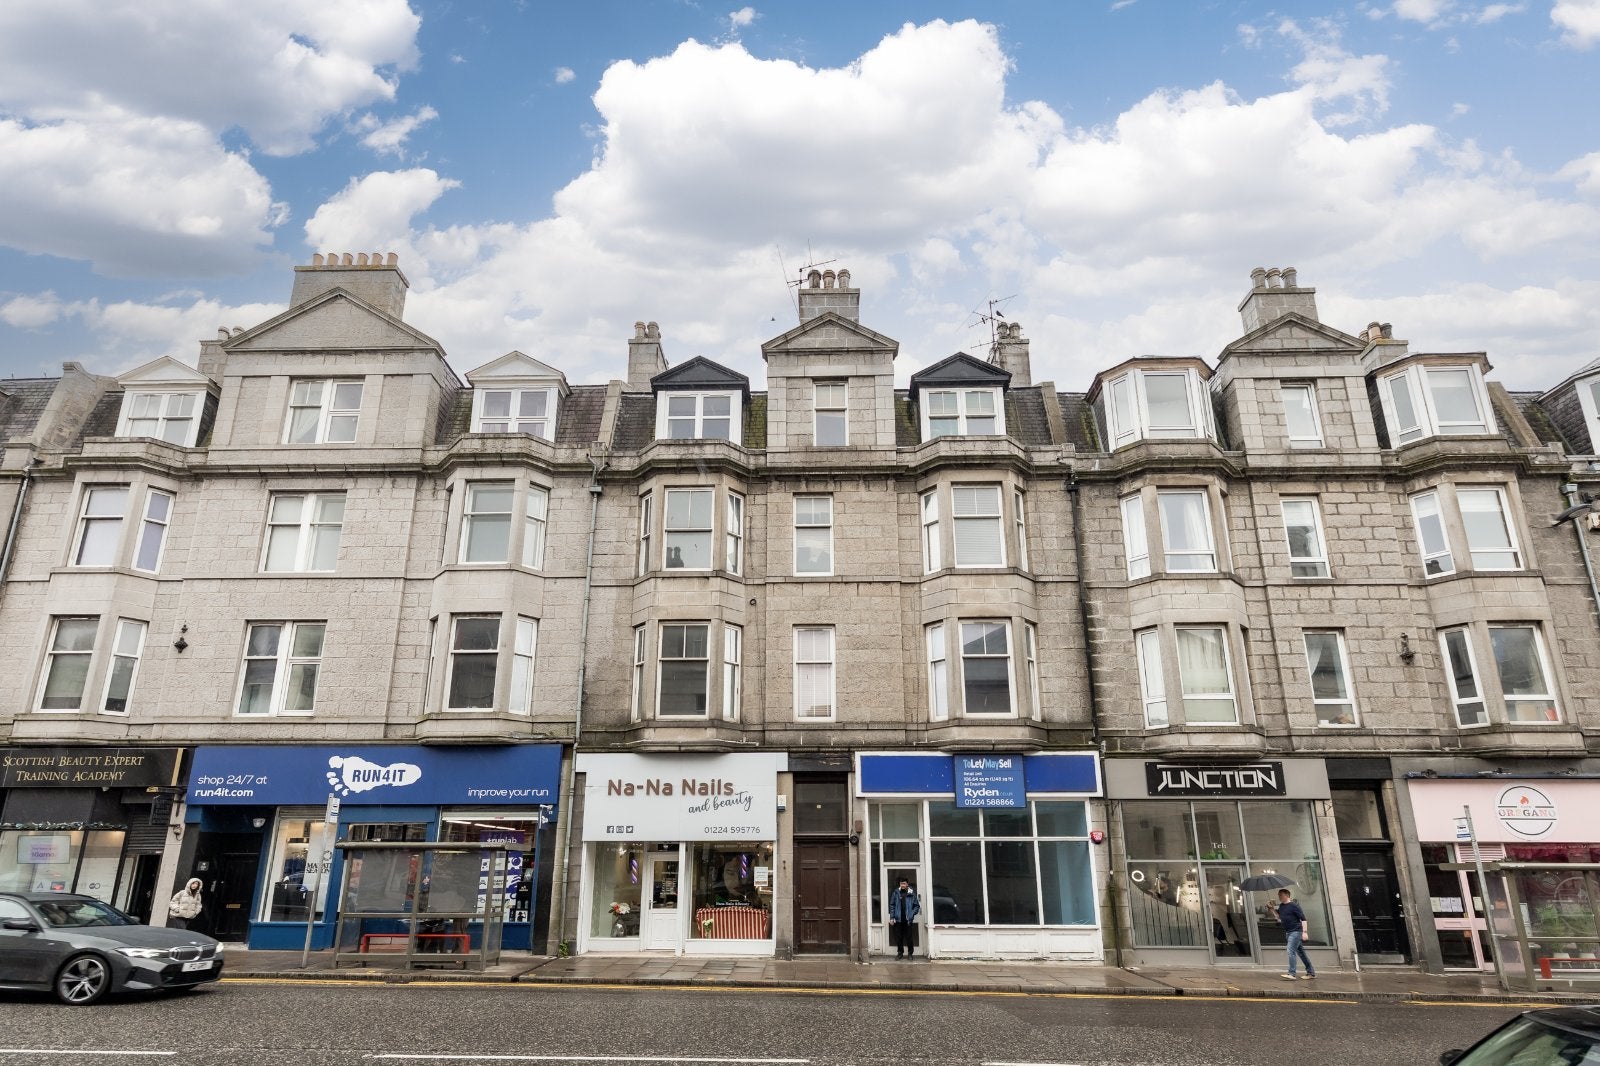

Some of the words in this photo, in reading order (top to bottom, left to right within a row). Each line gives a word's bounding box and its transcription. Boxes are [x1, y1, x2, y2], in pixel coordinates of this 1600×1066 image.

[3, 756, 55, 766] SCOTTISH
[58, 756, 102, 766] BEAUTY
[104, 756, 144, 766] EXPERT
[16, 770, 68, 781] TRAINING
[72, 771, 125, 781] ACADEMY
[197, 775, 224, 786] shop
[226, 774, 255, 785] 24/7
[255, 775, 268, 785] at
[352, 769, 406, 782] RUN4IT
[1157, 769, 1277, 792] JUNCTION
[194, 788, 254, 797] run4it.com
[467, 787, 508, 799] improve
[509, 789, 531, 799] your
[531, 789, 549, 797] run
[607, 779, 673, 796] Na-Na
[681, 779, 734, 796] Nails
[688, 797, 711, 814] and
[713, 790, 754, 812] beauty
[964, 798, 985, 806] 01224
[986, 798, 1015, 806] 588866
[704, 826, 728, 834] 01224
[730, 826, 761, 834] 595776
